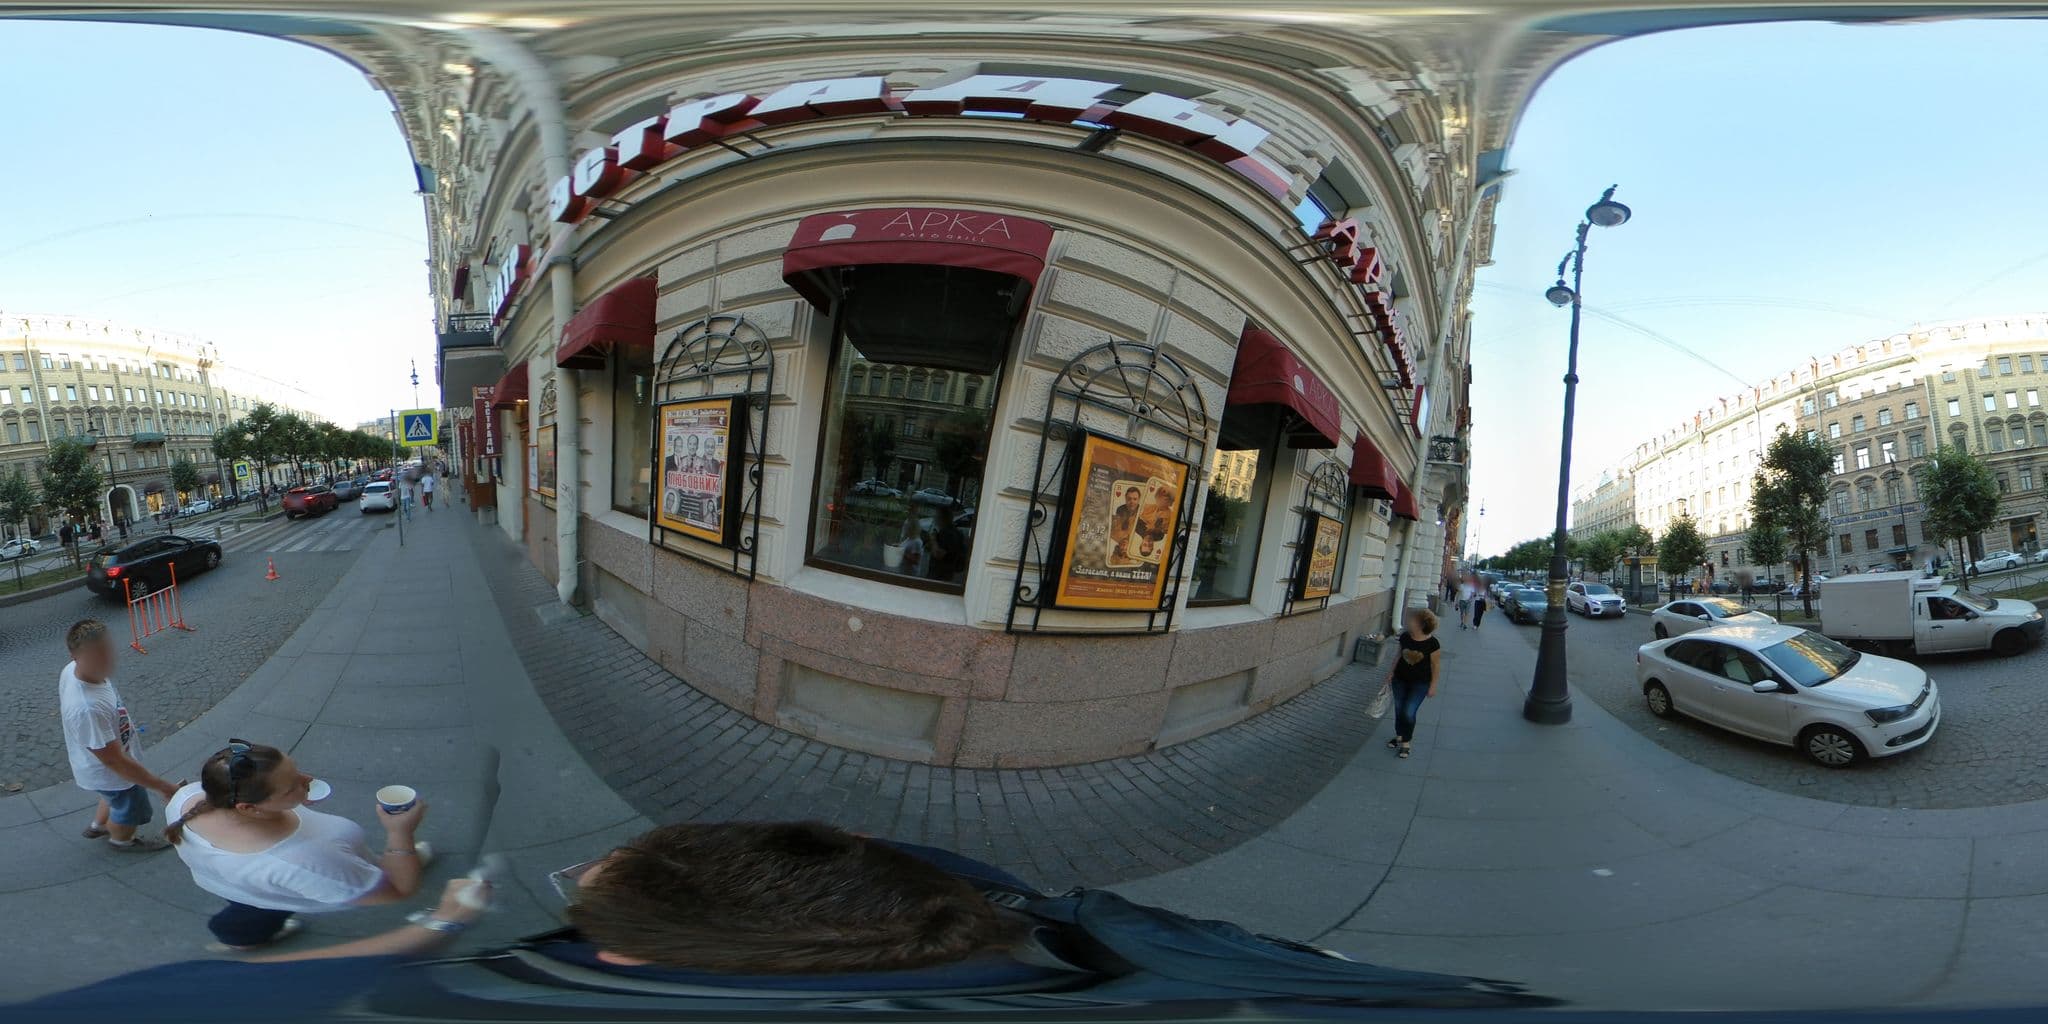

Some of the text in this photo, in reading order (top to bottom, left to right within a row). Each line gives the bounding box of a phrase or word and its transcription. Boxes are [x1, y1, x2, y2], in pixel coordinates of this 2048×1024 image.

[549, 74, 1295, 222] ЭСТРАДЫ
[881, 211, 1011, 239] АРКА
[484, 401, 494, 454] ЭСТРАДЫ
